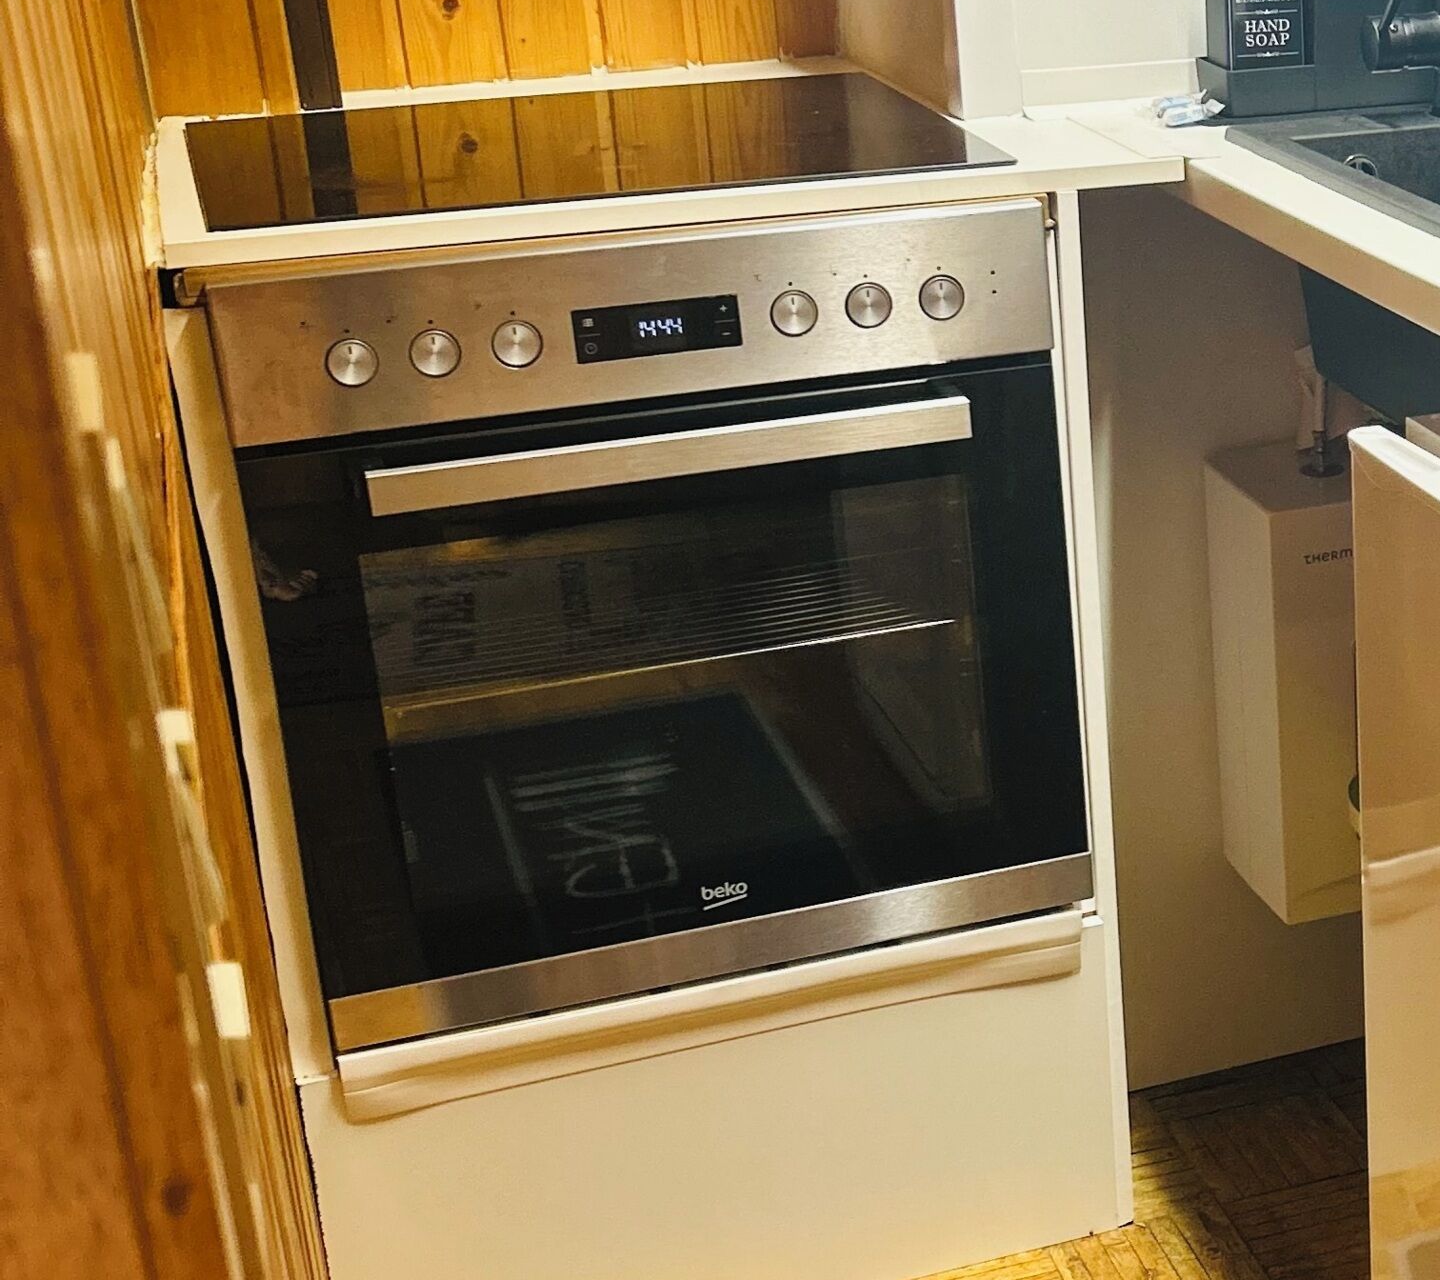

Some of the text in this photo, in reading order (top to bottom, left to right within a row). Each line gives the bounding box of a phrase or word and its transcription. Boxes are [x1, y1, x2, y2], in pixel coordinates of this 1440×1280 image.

[1244, 18, 1290, 33] HAND
[1245, 32, 1290, 47] SOAP
[701, 881, 748, 901] beko
